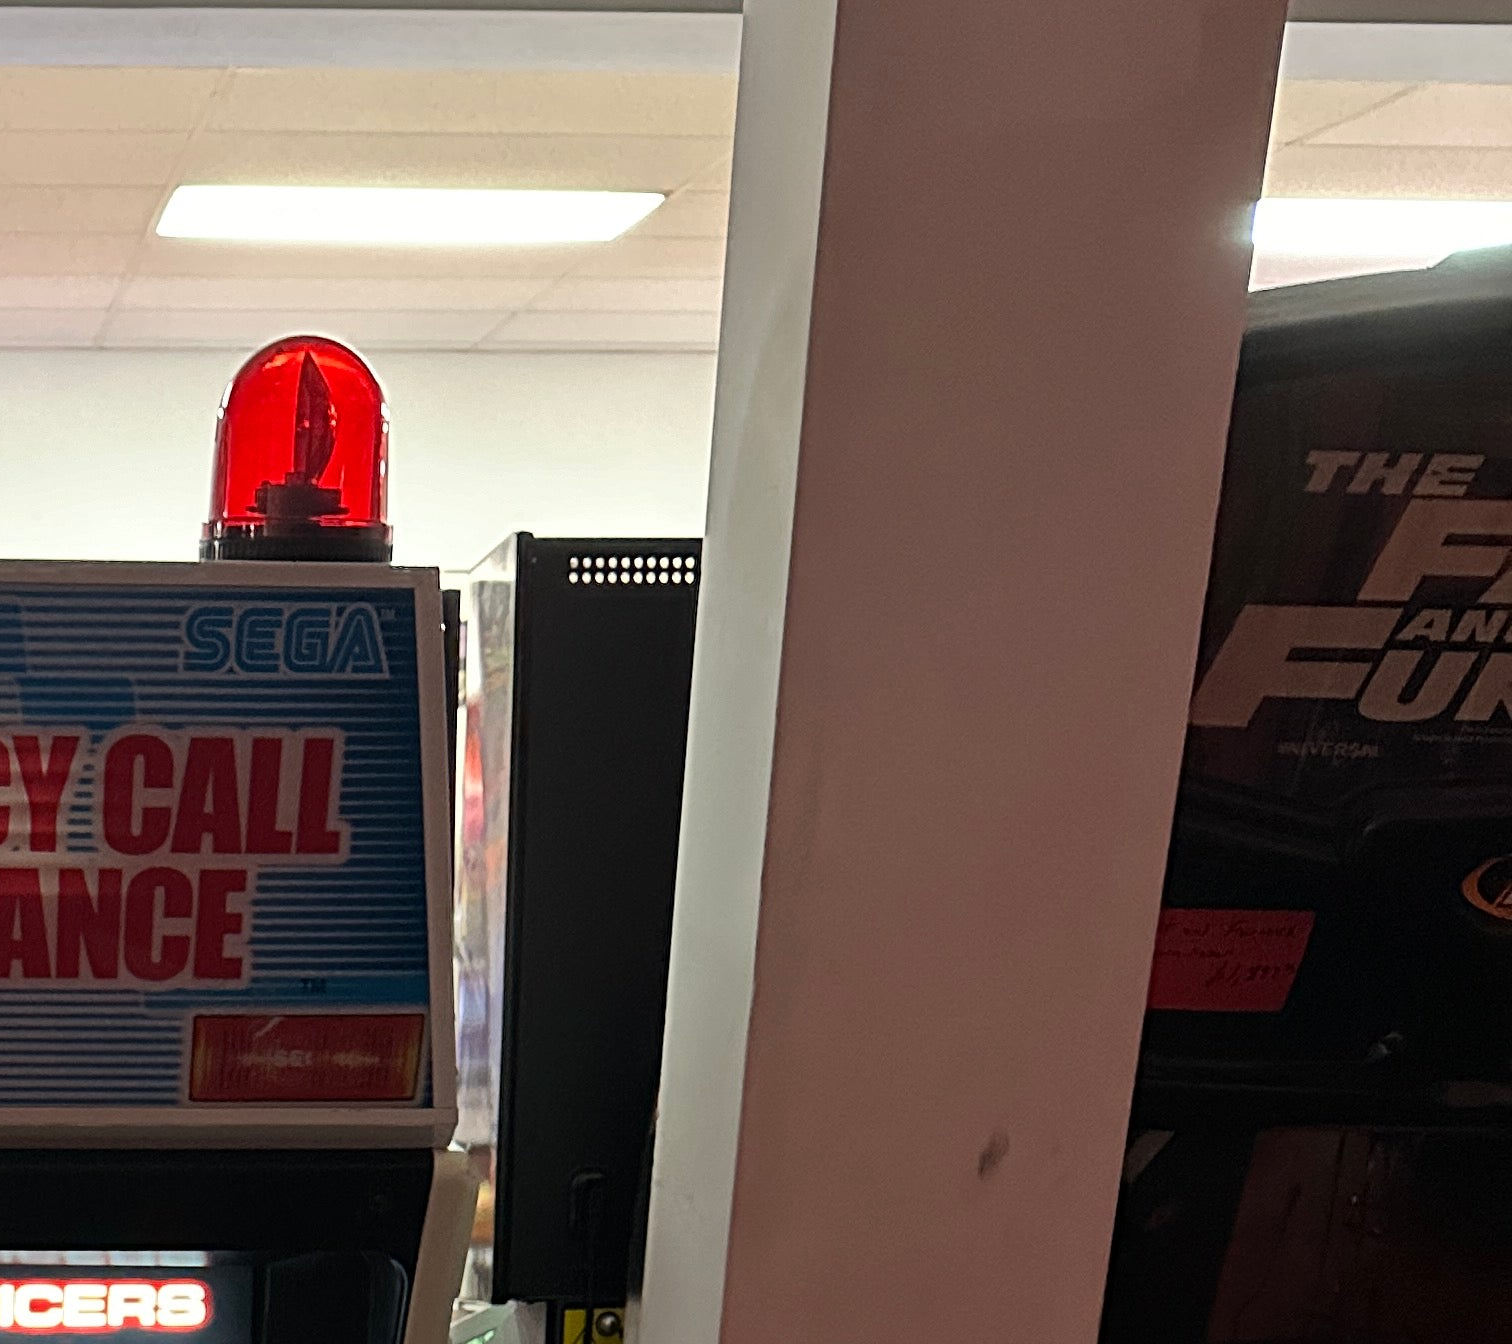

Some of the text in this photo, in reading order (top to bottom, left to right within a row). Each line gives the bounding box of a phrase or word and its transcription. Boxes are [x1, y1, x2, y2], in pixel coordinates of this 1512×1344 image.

[1304, 450, 1486, 496] THE
[180, 604, 388, 677] SEGA
[1394, 608, 1512, 644] AN
[102, 733, 341, 856] CALL
